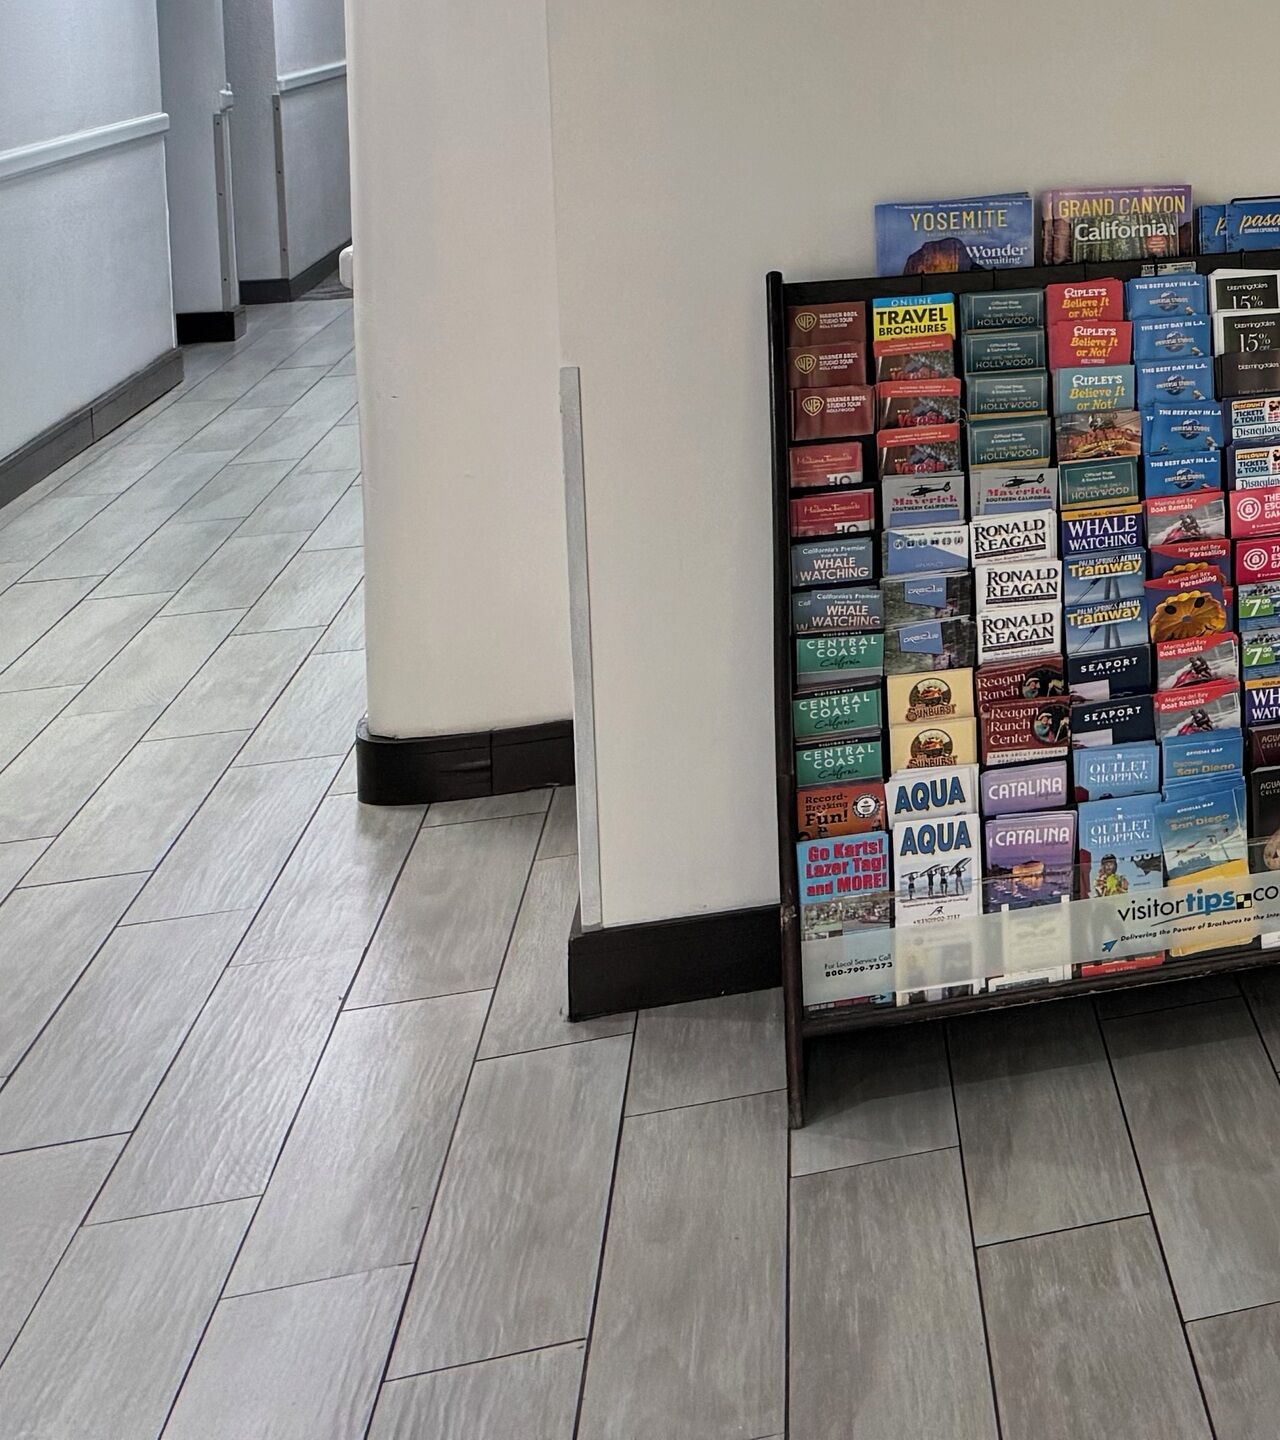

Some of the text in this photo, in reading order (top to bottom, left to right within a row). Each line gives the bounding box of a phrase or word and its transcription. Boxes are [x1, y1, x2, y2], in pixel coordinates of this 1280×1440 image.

[1058, 195, 1185, 218] GRAND CANYON
[910, 209, 1008, 232] YOSEMITE
[1074, 220, 1176, 241] California
[965, 243, 1028, 258] Wonder
[876, 307, 948, 326] TRAVEL
[976, 316, 1035, 326] HOLLYWOOD
[878, 324, 947, 336] BROCHURES
[1073, 325, 1117, 337] RIPLEY'S
[1070, 337, 1118, 347] Believe It
[1076, 346, 1110, 358] or Not!
[1235, 409, 1264, 418] TICKETS
[1264, 492, 1280, 501] THE
[973, 518, 1046, 542] RONALD
[1068, 515, 1138, 538] WHALE
[974, 532, 1047, 554] REAGAN
[1068, 532, 1137, 551] WATCHING
[813, 557, 856, 570] WHALE
[1068, 559, 1142, 578] Tramway
[800, 566, 869, 582] WATCHING
[986, 567, 1059, 587] RONALD
[986, 581, 1058, 599] REAGAN
[981, 612, 1054, 635] RONALD
[1066, 607, 1142, 627] Tramway
[806, 636, 877, 650] CENTRAL
[981, 625, 1054, 647] REAGAN
[816, 646, 866, 658] COAST
[1080, 657, 1139, 674] SEAPORT
[990, 708, 1039, 720] Reagan
[990, 719, 1031, 733] Ranch
[989, 734, 1032, 746] Center
[803, 744, 875, 762] CENTRAL
[813, 754, 865, 769] COAST
[817, 767, 859, 780] California
[1089, 760, 1148, 774] OUTLET
[1176, 763, 1235, 776] San Diego
[894, 776, 966, 815] AQUA
[988, 777, 1063, 800] CATALINA
[805, 793, 848, 804] Record-
[805, 802, 849, 812] Breaking
[805, 810, 849, 827] Fun!
[900, 820, 972, 857] AQUA
[995, 827, 1070, 847] CATALINA
[808, 837, 884, 863] Go Karts!
[805, 854, 887, 879] Lazer Tag!
[806, 872, 887, 897] and MORE!
[1120, 931, 1157, 942] Delivering
[1159, 928, 1171, 936] the
[1172, 925, 1196, 935] Power
[1197, 922, 1206, 930] of
[1207, 918, 1242, 929] Brochures
[1253, 913, 1265, 921] the
[836, 960, 853, 968] Local
[854, 958, 877, 966] Service
[879, 953, 892, 962] Call
[825, 961, 893, 978] 800-799-7373
